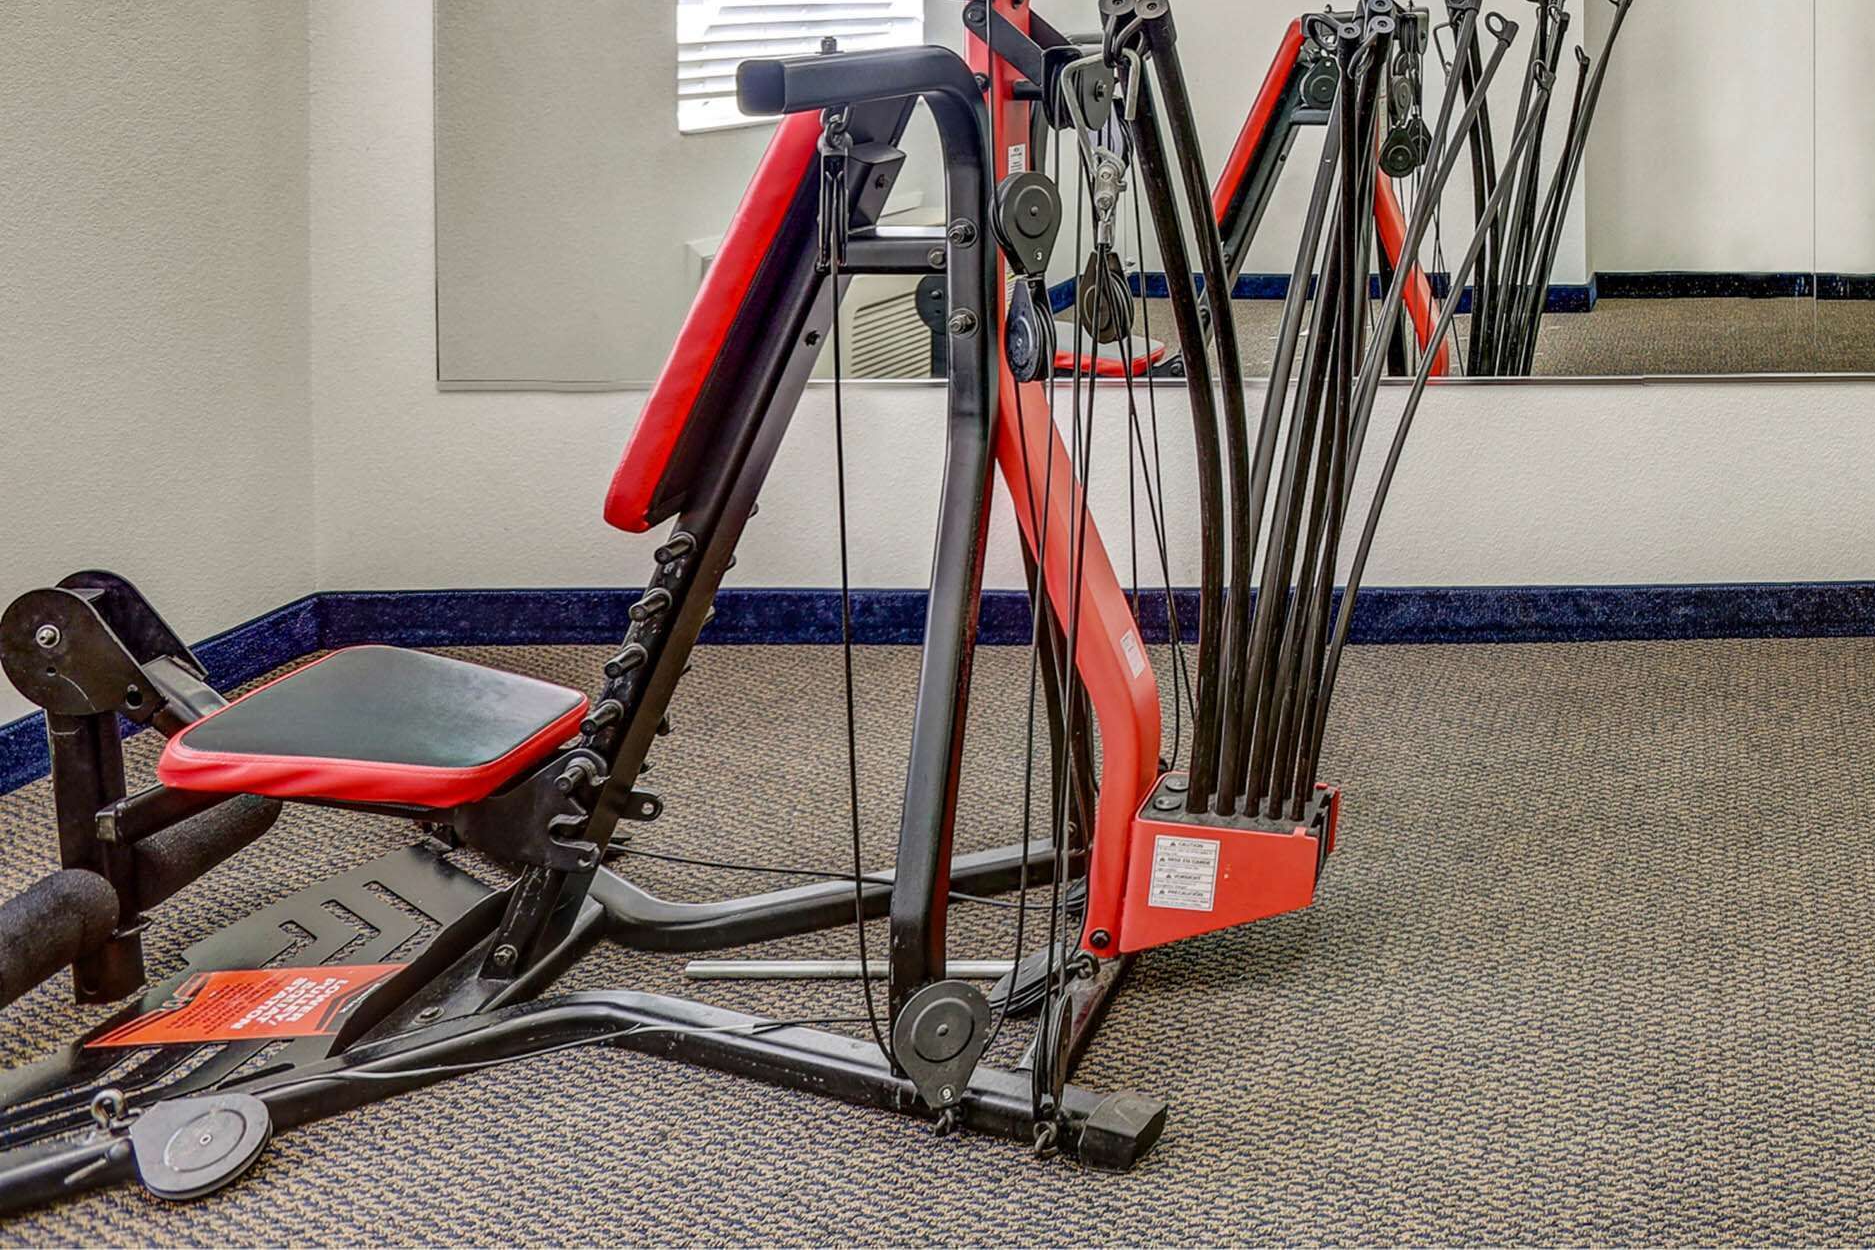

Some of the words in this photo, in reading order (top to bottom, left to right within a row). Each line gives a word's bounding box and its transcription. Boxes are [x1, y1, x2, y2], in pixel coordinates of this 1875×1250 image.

[1036, 251, 1042, 260] 3
[231, 977, 308, 1029] STATION
[285, 979, 349, 1023] LOWER
